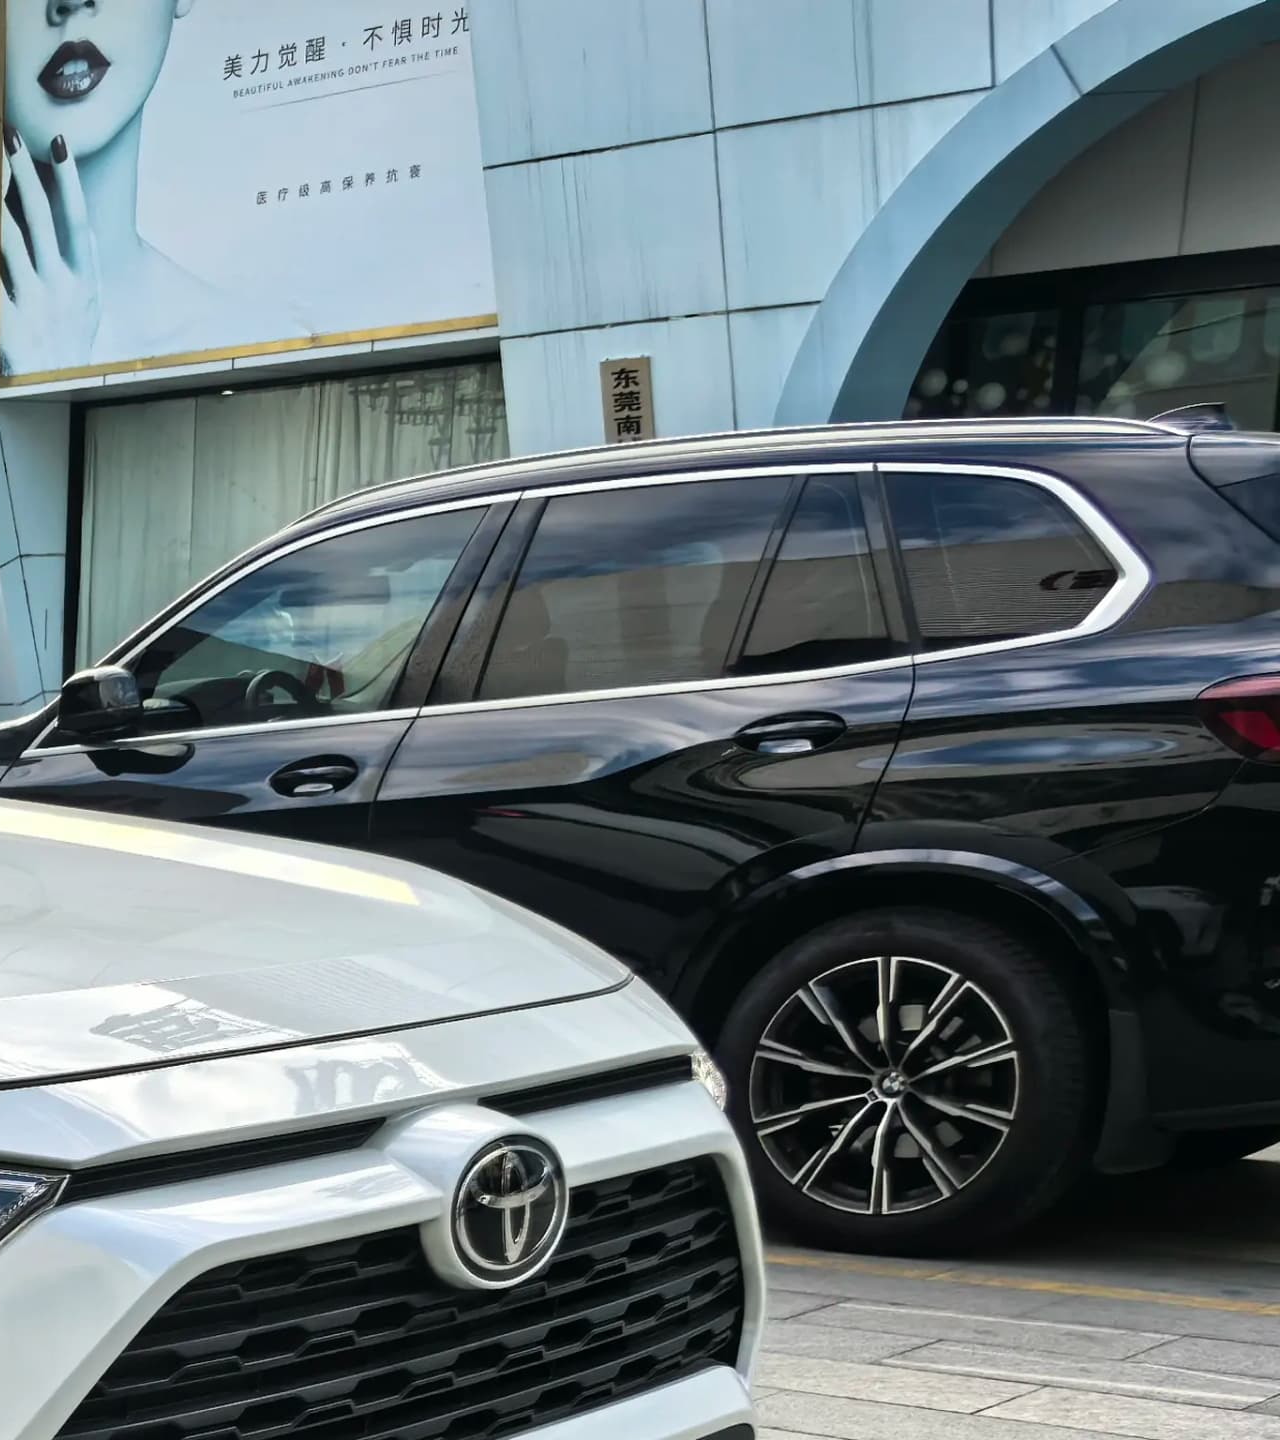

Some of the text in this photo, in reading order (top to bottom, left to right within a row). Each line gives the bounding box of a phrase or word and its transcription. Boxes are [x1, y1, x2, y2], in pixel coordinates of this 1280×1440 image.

[347, 61, 379, 76] DON'T
[382, 56, 407, 69] FEAR
[411, 51, 430, 63] THE
[434, 46, 459, 58] TIME
[610, 368, 643, 442] 东莞南
